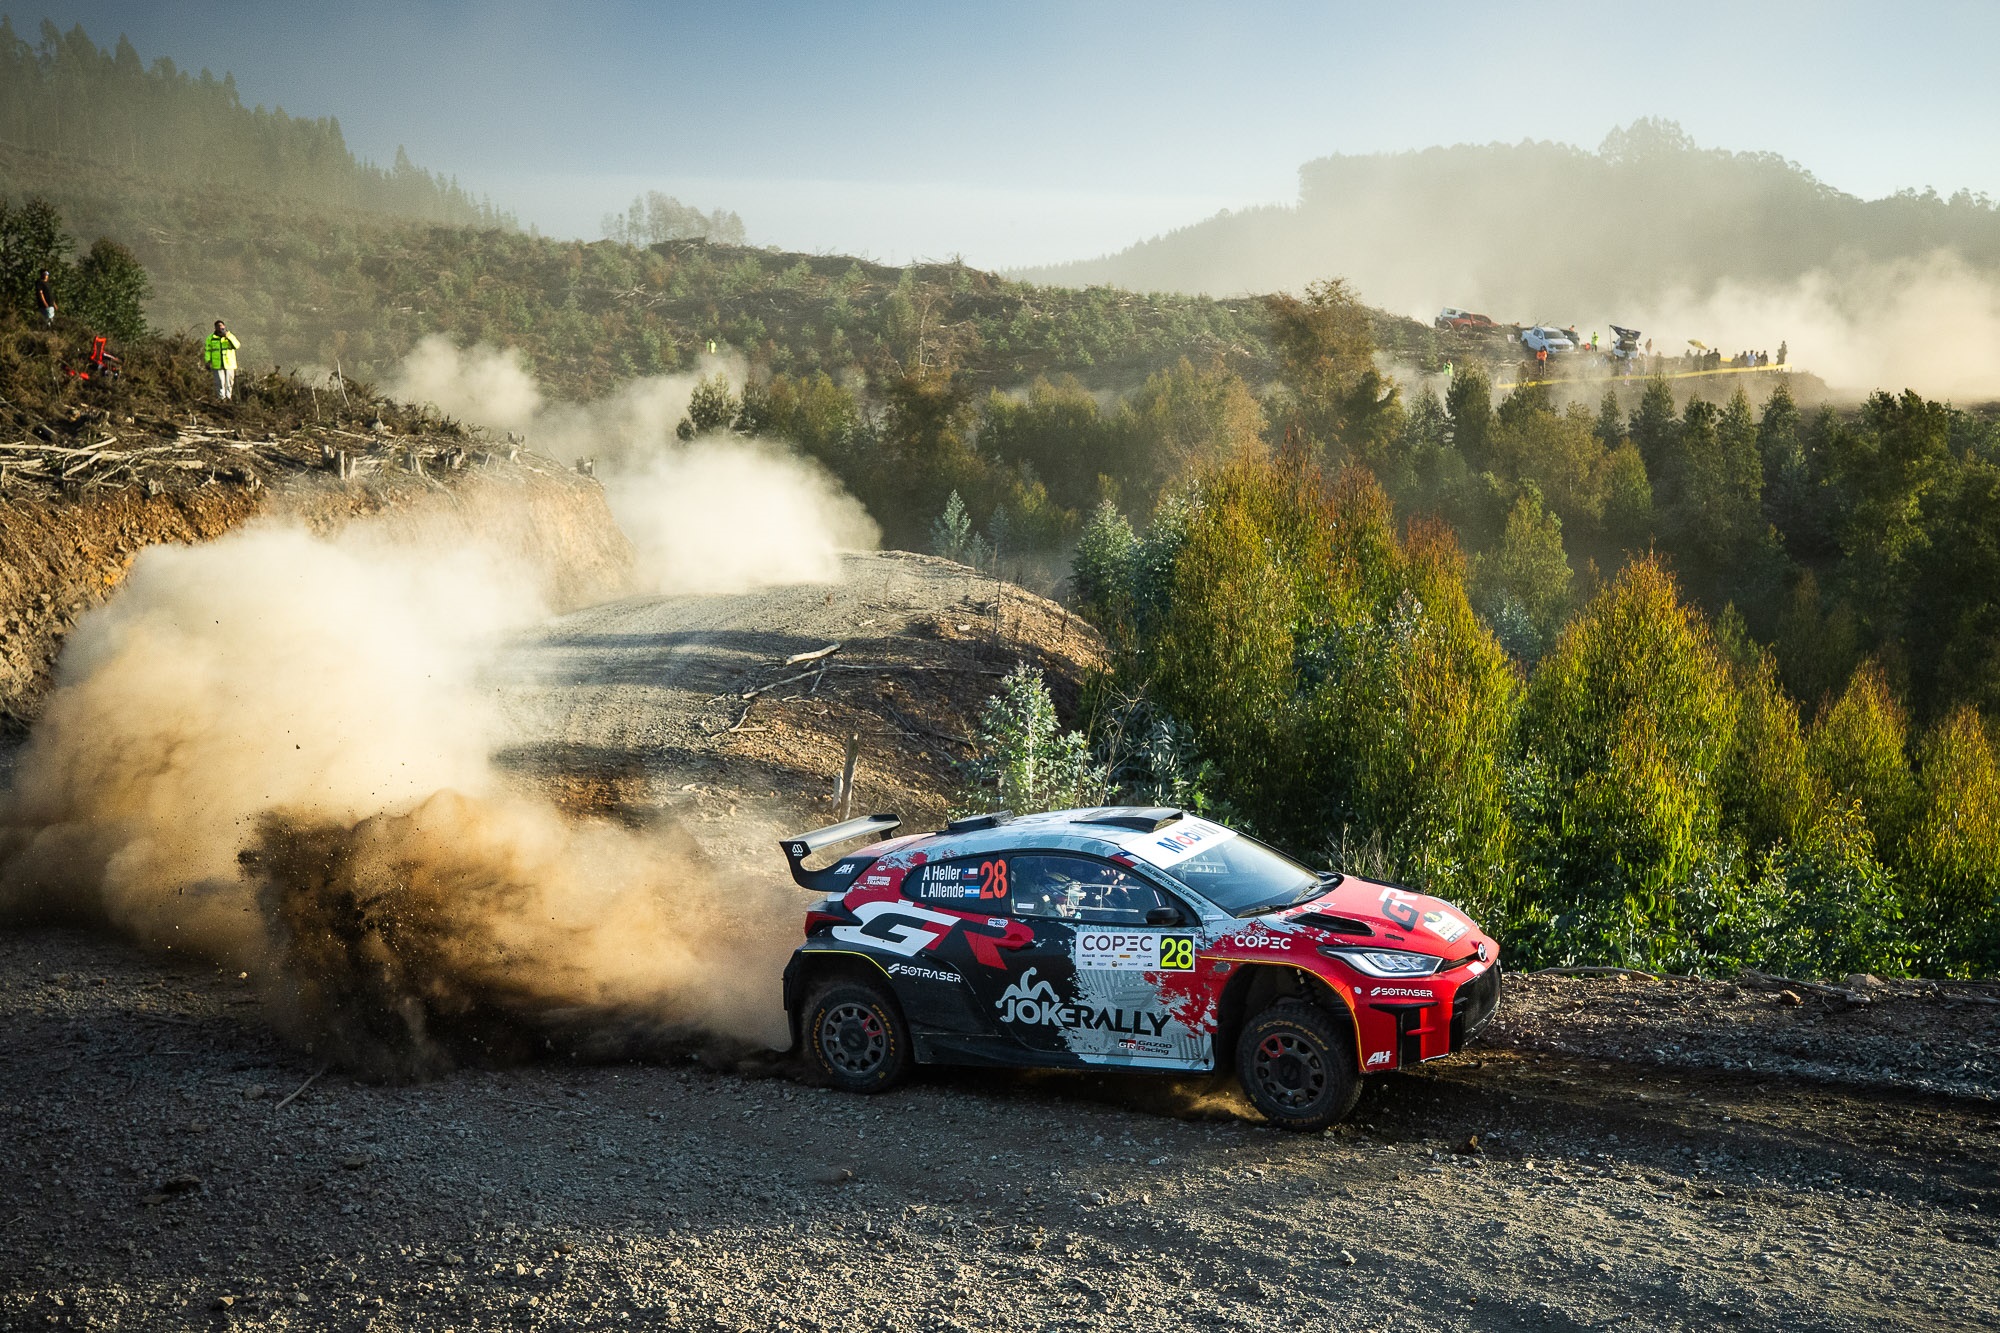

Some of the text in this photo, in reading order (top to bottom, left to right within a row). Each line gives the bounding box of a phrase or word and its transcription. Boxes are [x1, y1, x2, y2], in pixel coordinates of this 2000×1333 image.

[922, 865, 962, 881] A Heller
[979, 859, 1008, 899] 28
[920, 882, 965, 898] L Allende
[1378, 887, 1420, 932] GR
[831, 901, 1035, 971] GR
[1234, 935, 1292, 950] COPEC
[1082, 935, 1194, 970] COPEC 28
[900, 965, 962, 983] SOTRASER
[1381, 987, 1434, 998] SOTRASER
[1137, 1046, 1169, 1055] Racing
